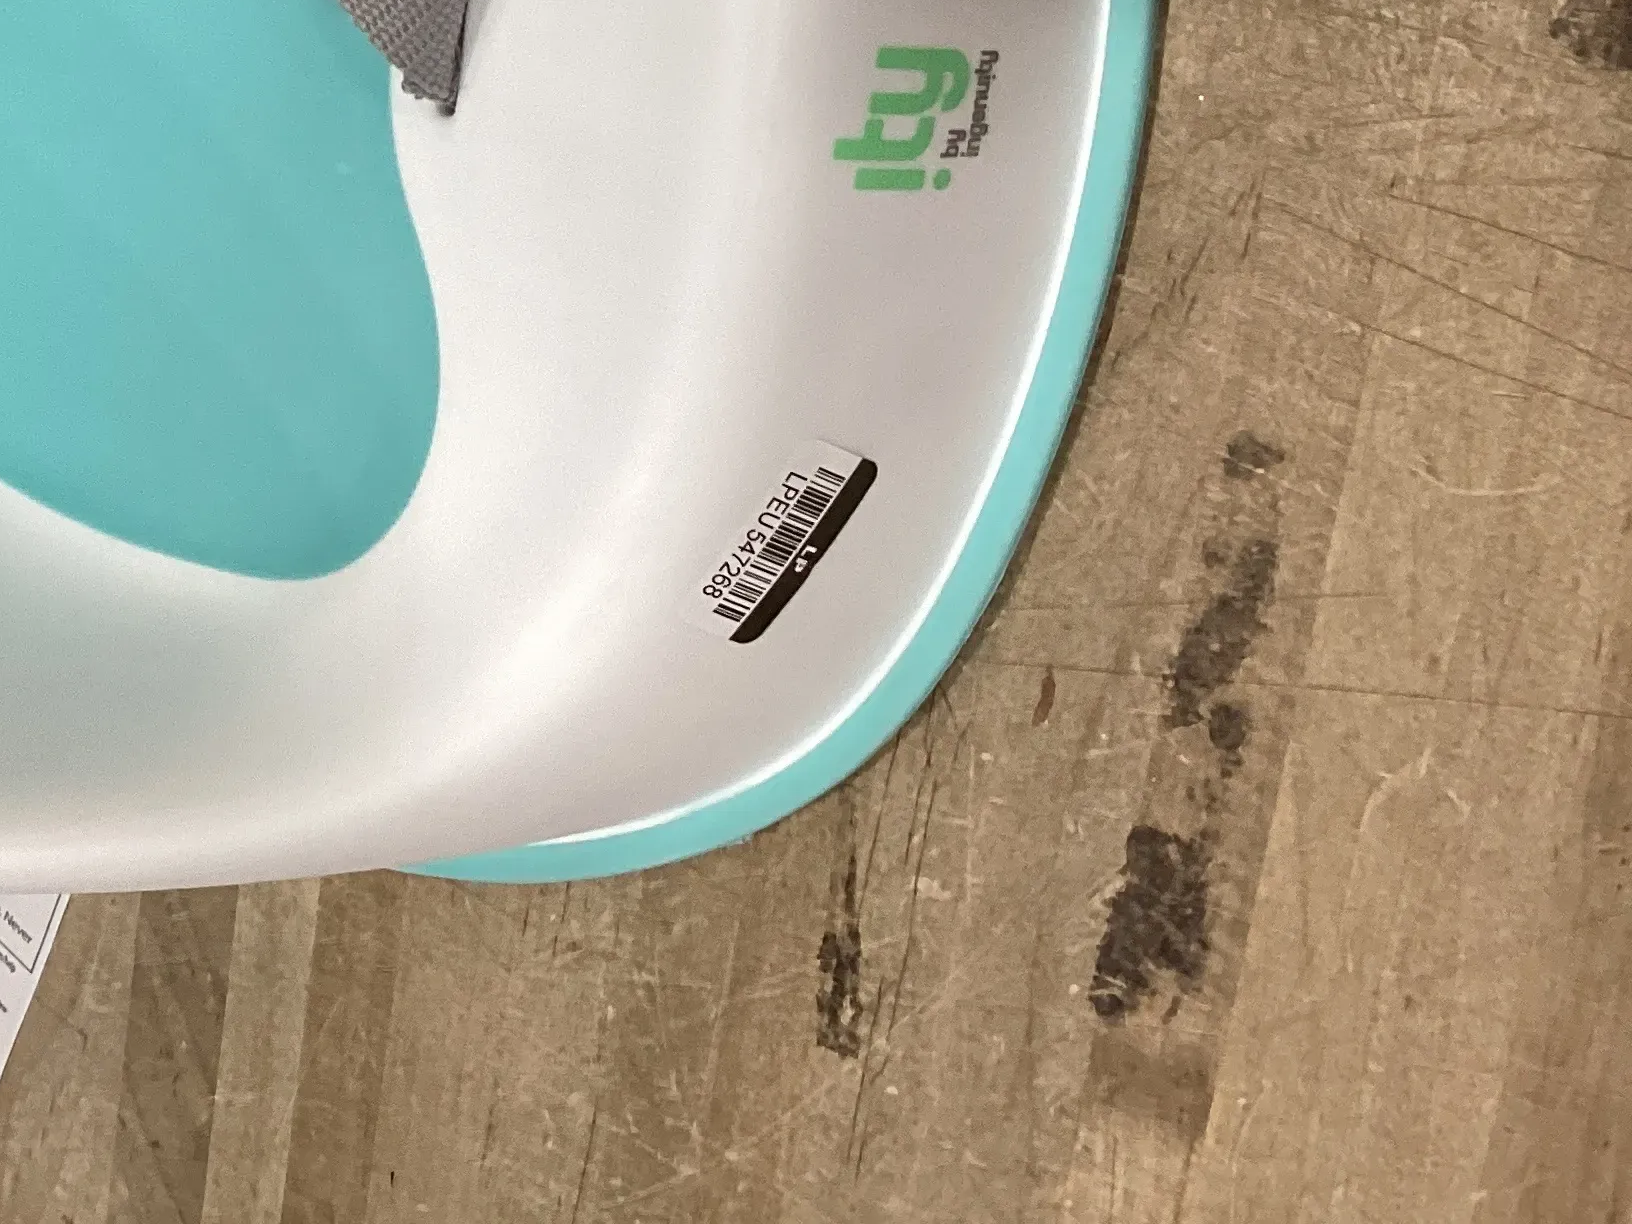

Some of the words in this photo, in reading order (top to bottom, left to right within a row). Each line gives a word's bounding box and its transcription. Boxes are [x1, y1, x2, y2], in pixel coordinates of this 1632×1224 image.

[960, 49, 999, 158] ingenuity
[939, 129, 966, 158] by
[757, 471, 808, 529] LPEU
[702, 528, 766, 599] 547268
[793, 545, 818, 573] LP
[3, 911, 32, 944] Never
